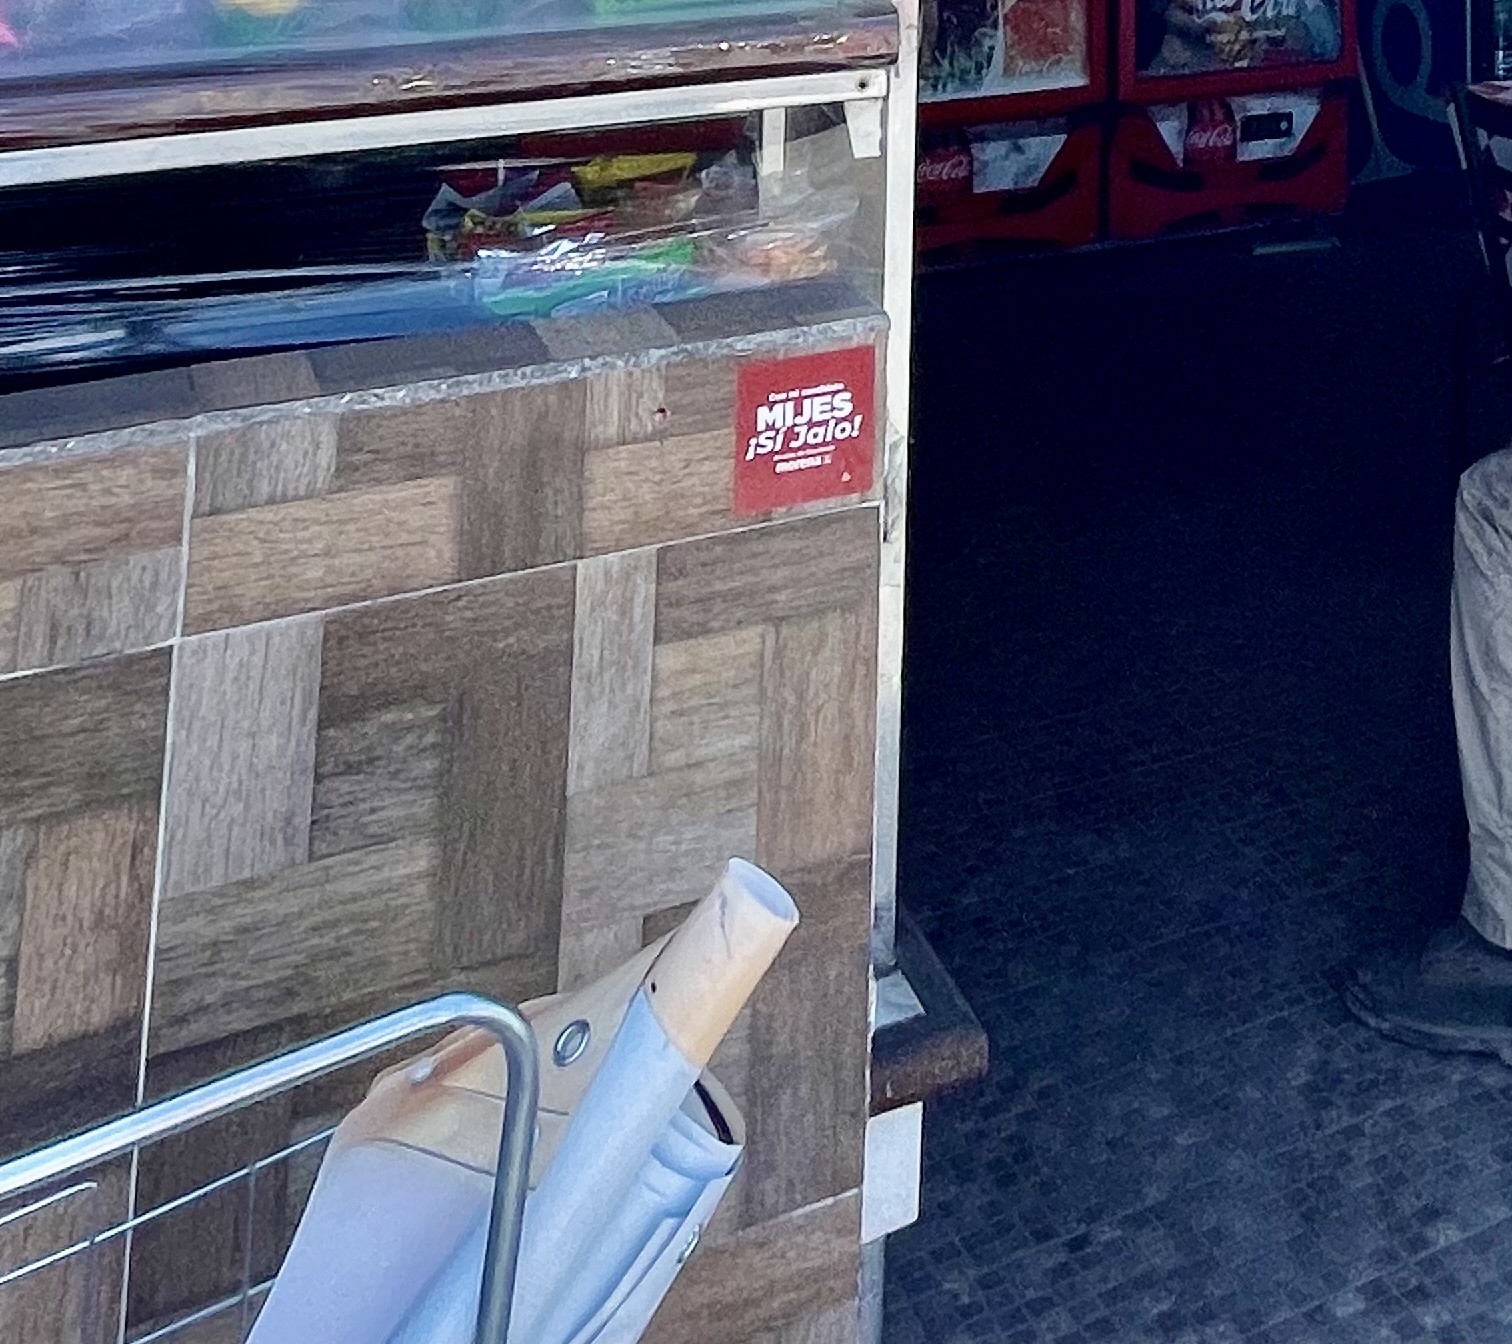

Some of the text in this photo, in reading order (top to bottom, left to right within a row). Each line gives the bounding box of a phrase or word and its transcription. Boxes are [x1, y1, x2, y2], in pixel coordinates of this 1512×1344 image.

[756, 390, 854, 433] MIJES
[745, 427, 787, 462] ¡Sí
[788, 414, 864, 450] Jalo!
